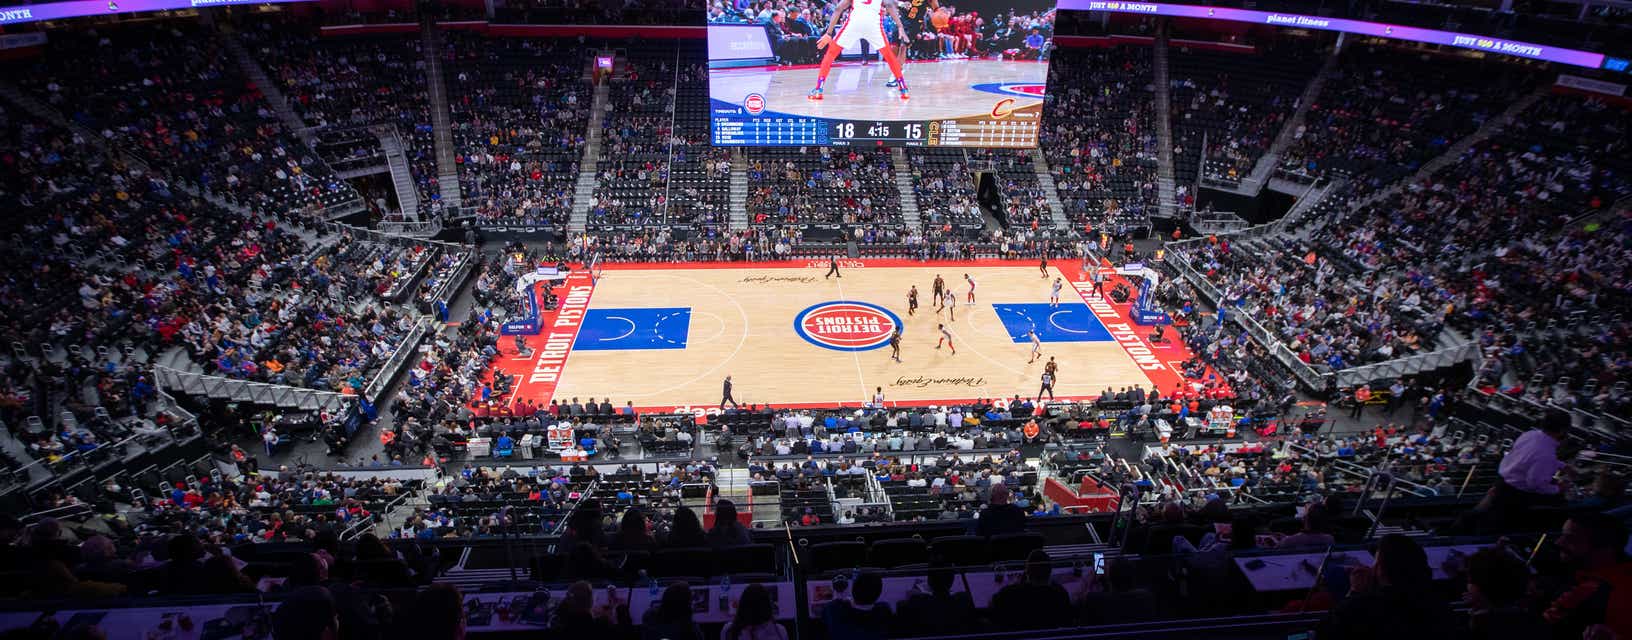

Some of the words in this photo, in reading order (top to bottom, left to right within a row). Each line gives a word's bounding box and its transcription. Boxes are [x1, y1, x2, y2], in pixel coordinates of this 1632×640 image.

[1089, 1, 1106, 10] JUST
[1127, 3, 1157, 12] MONTH
[1266, 14, 1296, 24] planet
[1296, 16, 1329, 27] fitness
[1453, 36, 1477, 45] JUST
[1493, 41, 1501, 50] A
[1502, 43, 1542, 56] MONTH
[835, 122, 855, 139] 18
[867, 126, 890, 137] 4:15
[903, 123, 922, 139] 15
[553, 286, 592, 327] PISTONS
[1072, 281, 1121, 319] DETROIT
[815, 315, 881, 325] PISTONS
[818, 324, 882, 334] DETROIT
[1107, 323, 1167, 371] PISTONS
[528, 332, 573, 384] DETROIT
